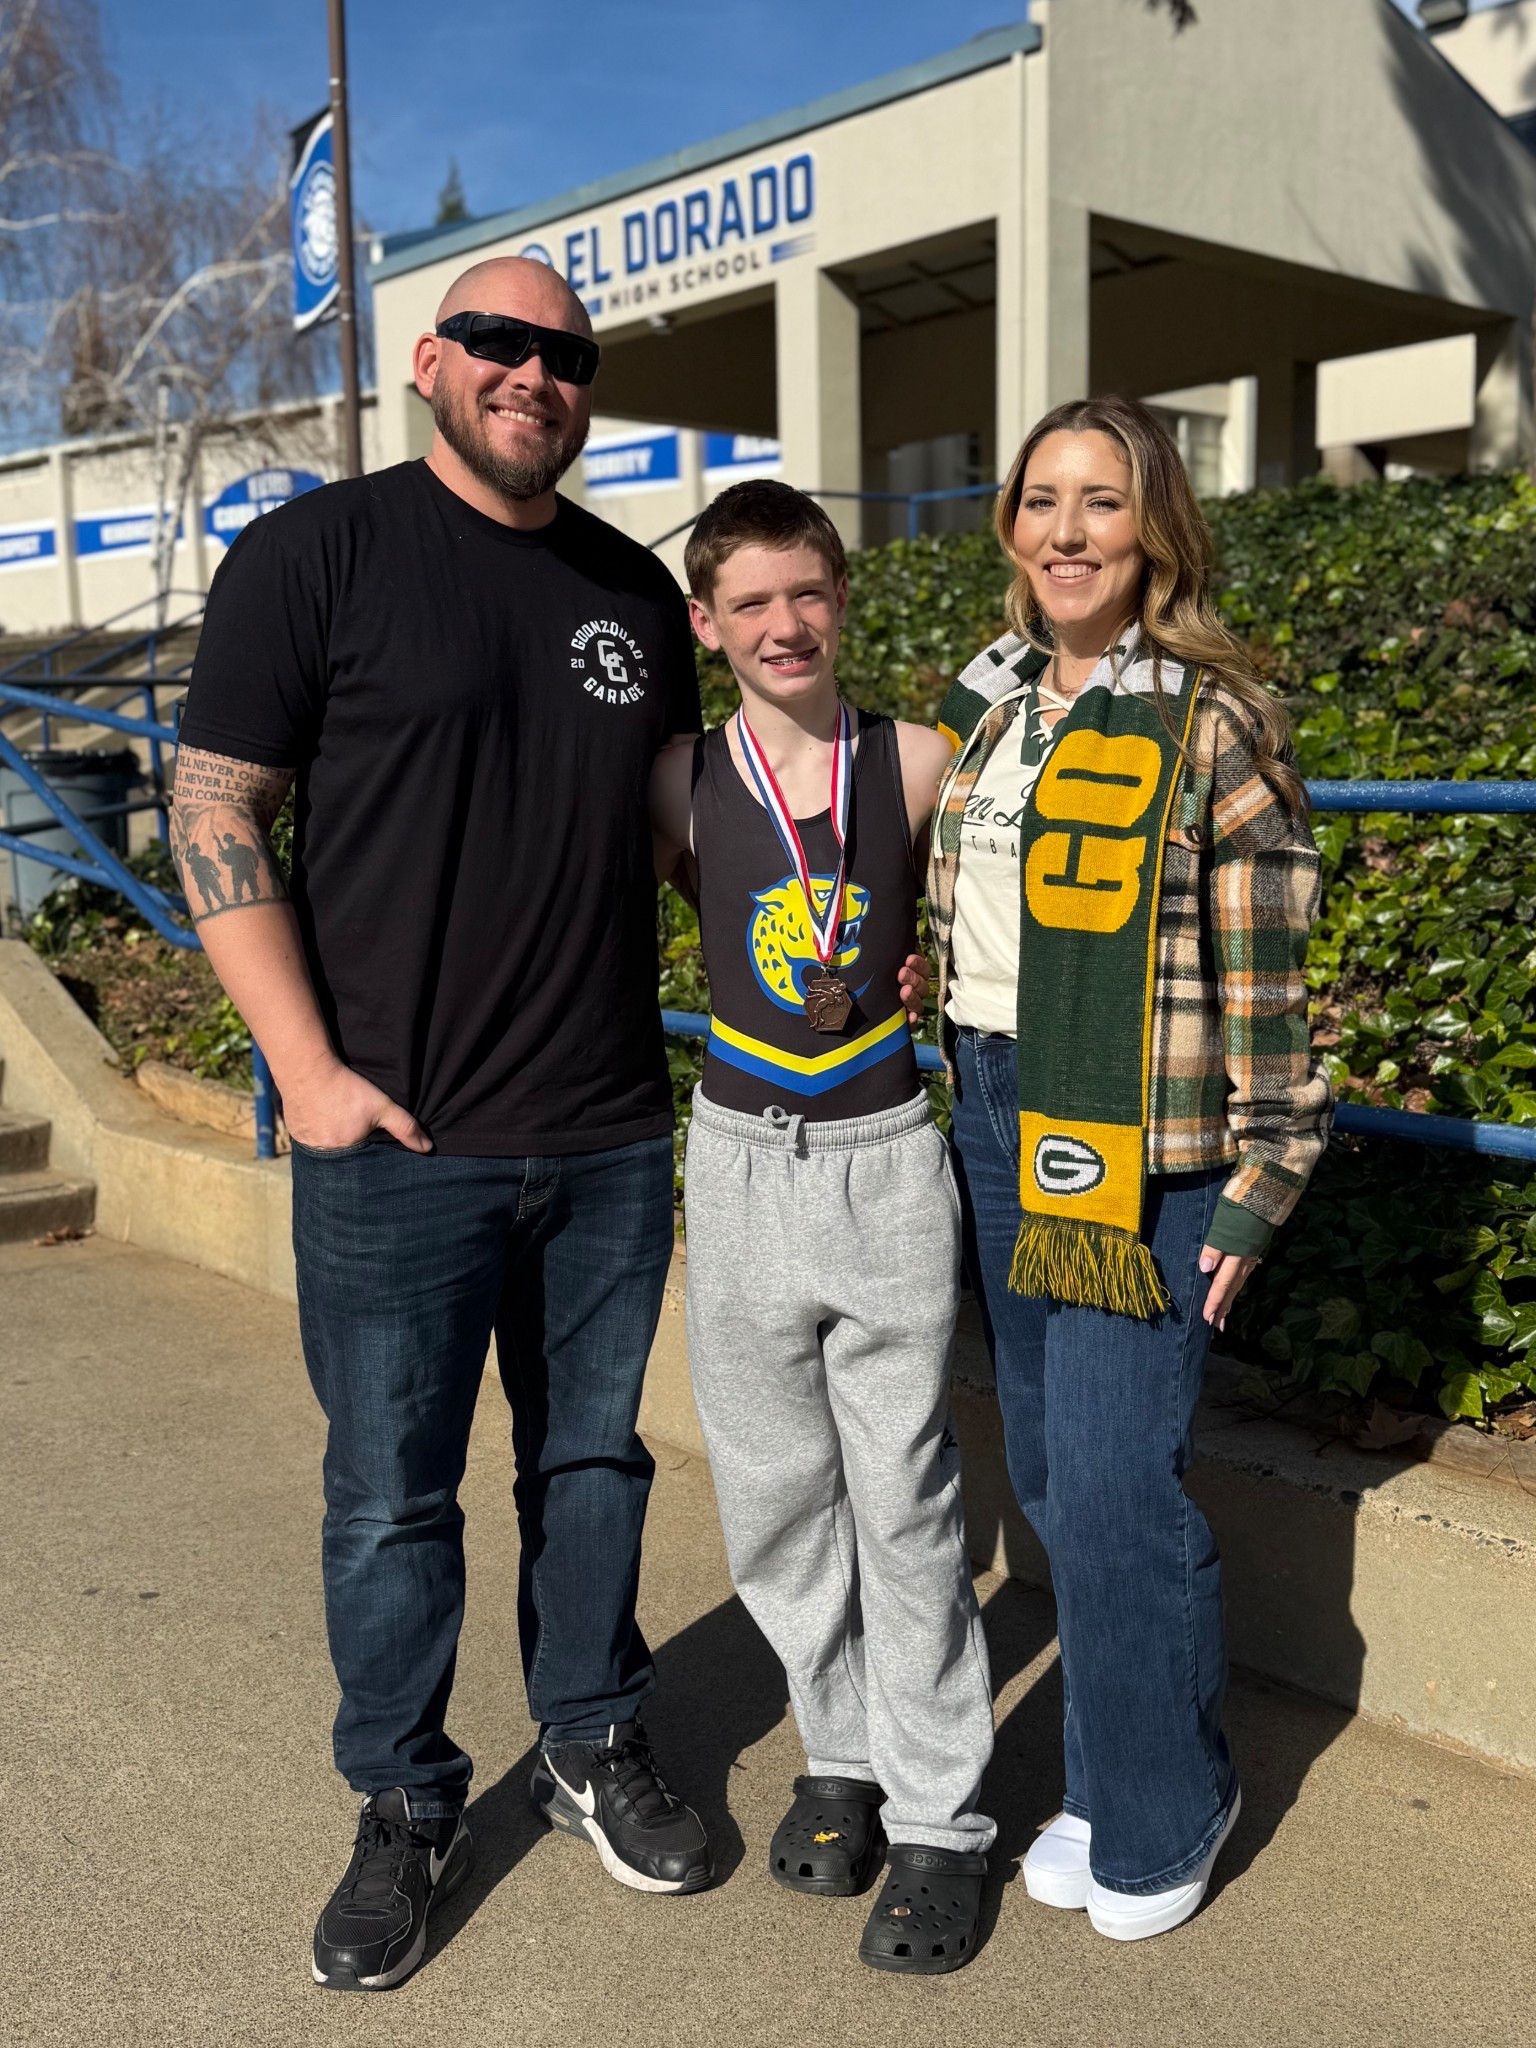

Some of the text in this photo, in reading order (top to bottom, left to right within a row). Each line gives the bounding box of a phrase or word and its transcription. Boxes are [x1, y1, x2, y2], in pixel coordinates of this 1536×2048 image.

[565, 154, 812, 290] EL DORADO
[608, 251, 761, 311] HIGH SCHOOL
[570, 620, 644, 660] GOONZQUAD
[570, 658, 585, 669] 20
[583, 676, 645, 705] GARAGE
[192, 758, 235, 778] NEVER
[184, 771, 221, 788] NEVER
[224, 779, 269, 798] LEAVE
